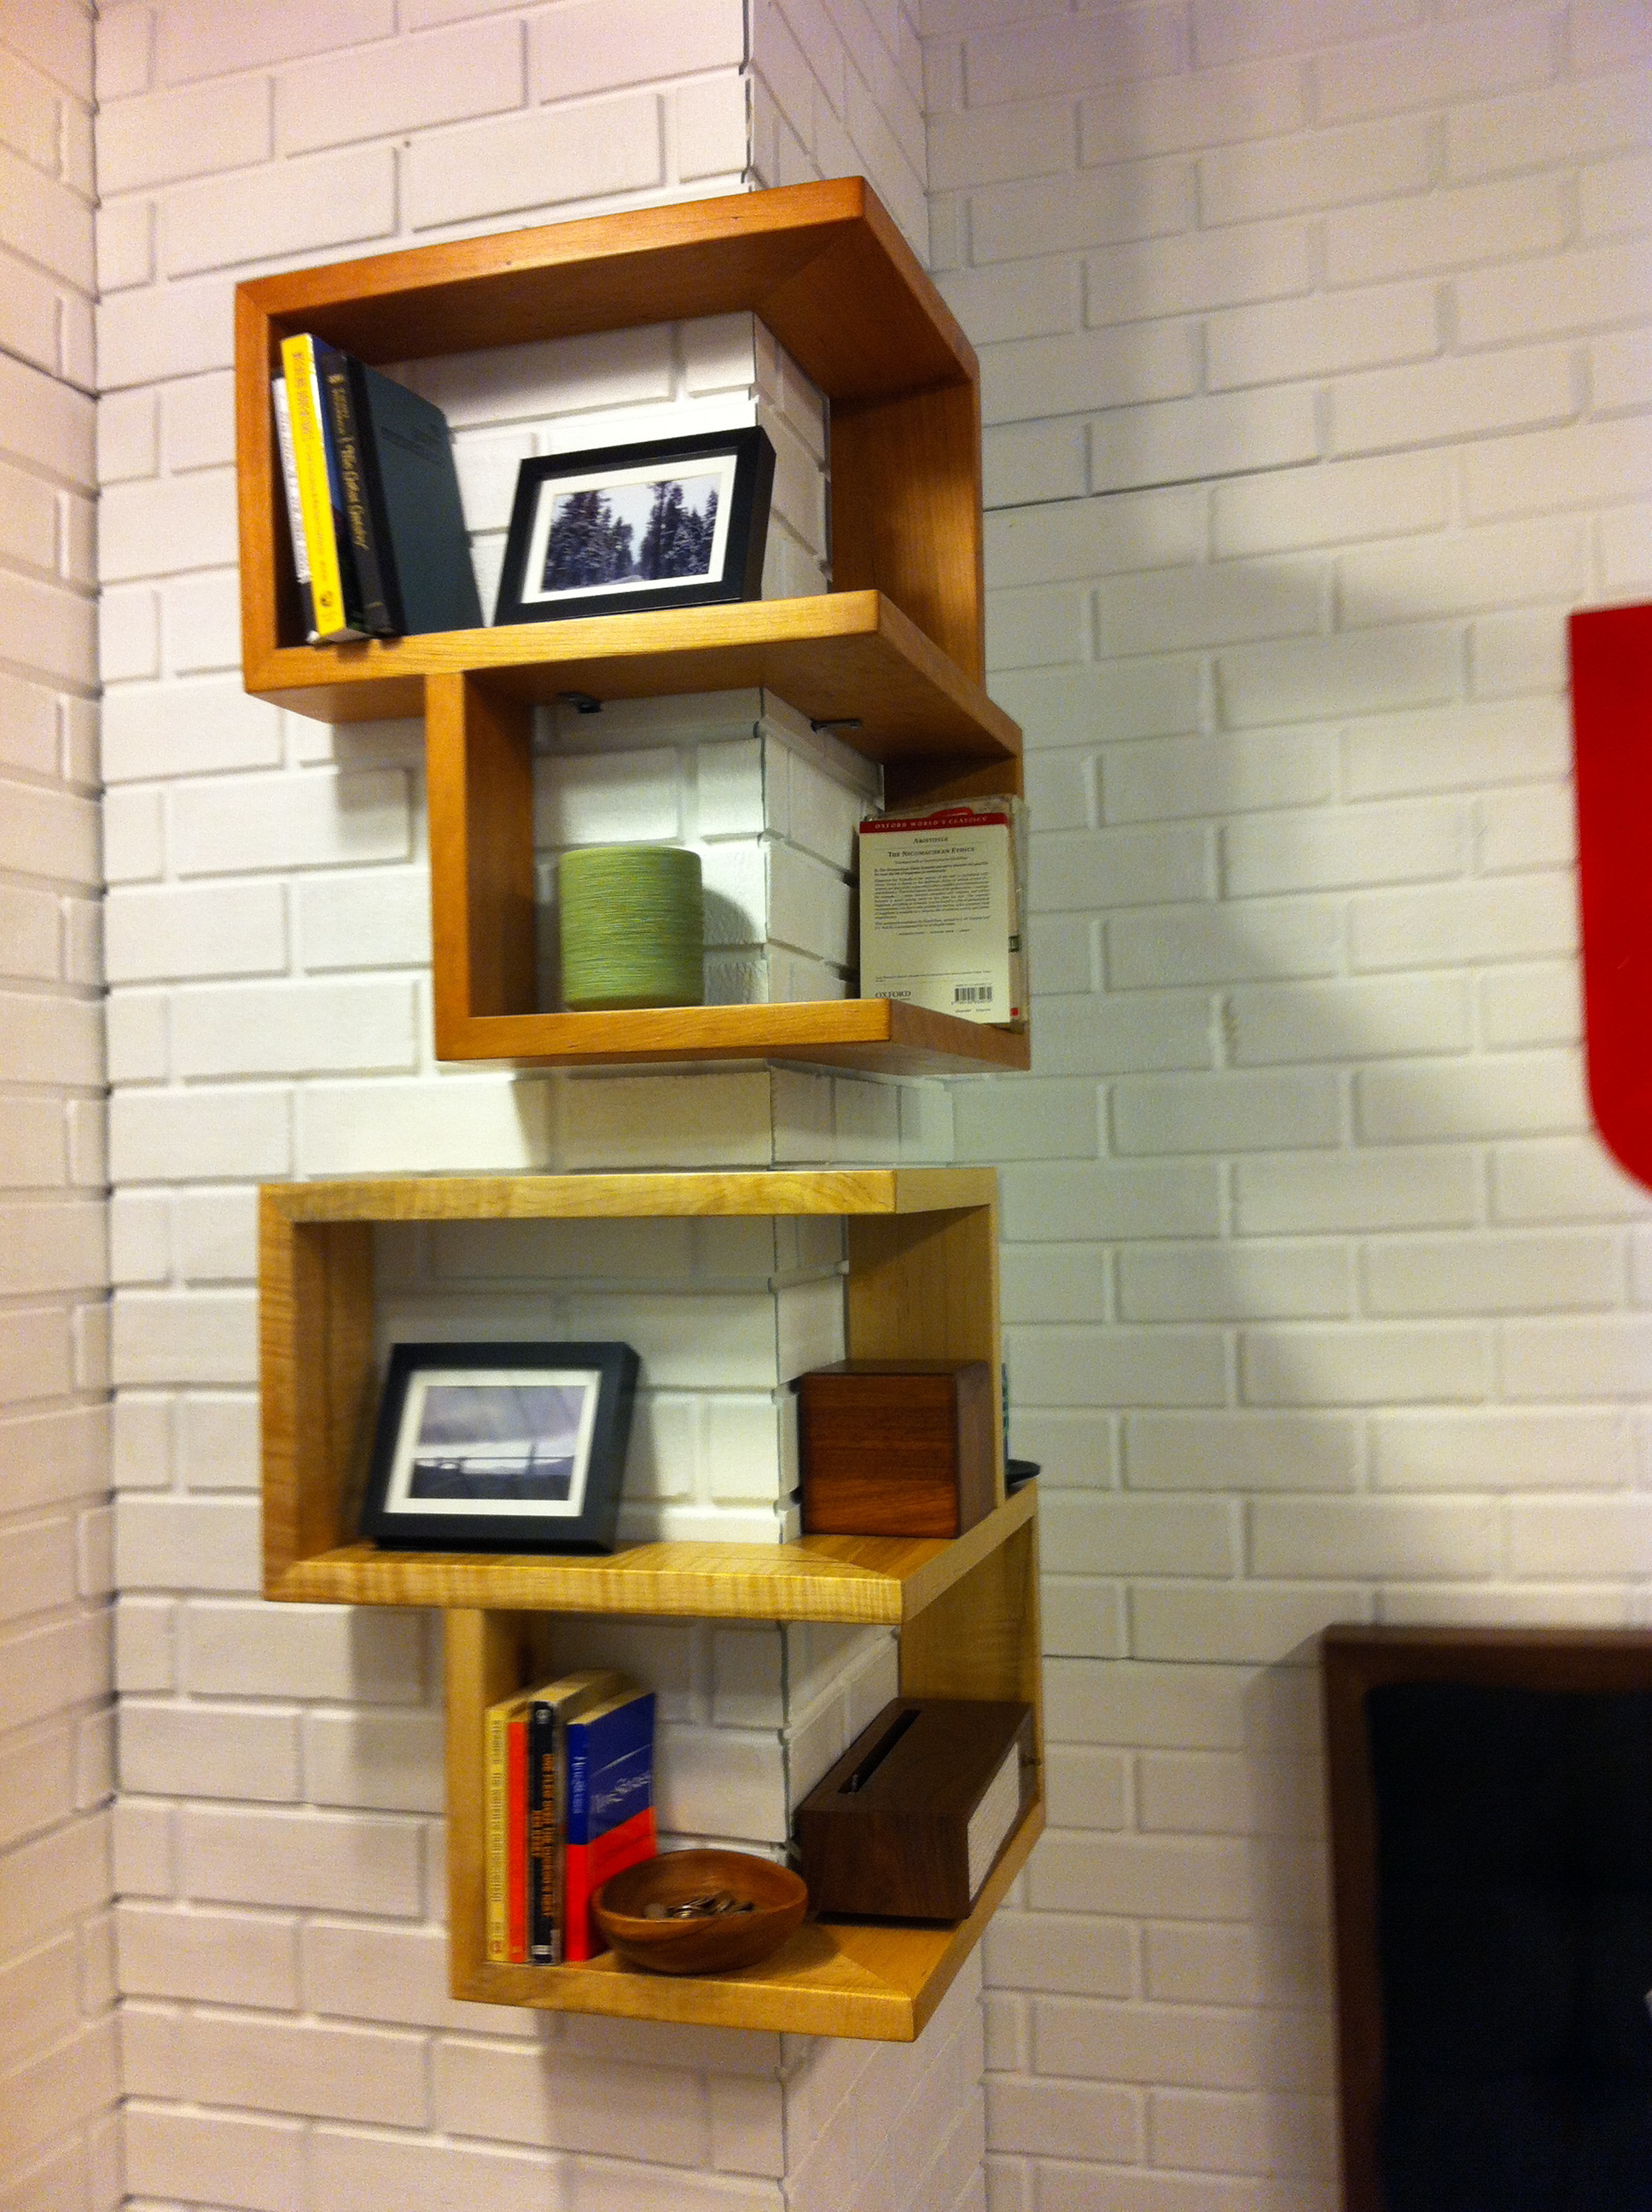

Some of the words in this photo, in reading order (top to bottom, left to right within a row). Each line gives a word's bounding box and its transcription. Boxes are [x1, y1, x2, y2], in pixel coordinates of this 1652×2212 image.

[910, 819, 946, 828] WORLD'S
[948, 816, 988, 825] CLASSICS
[875, 990, 911, 999] OXFORD
